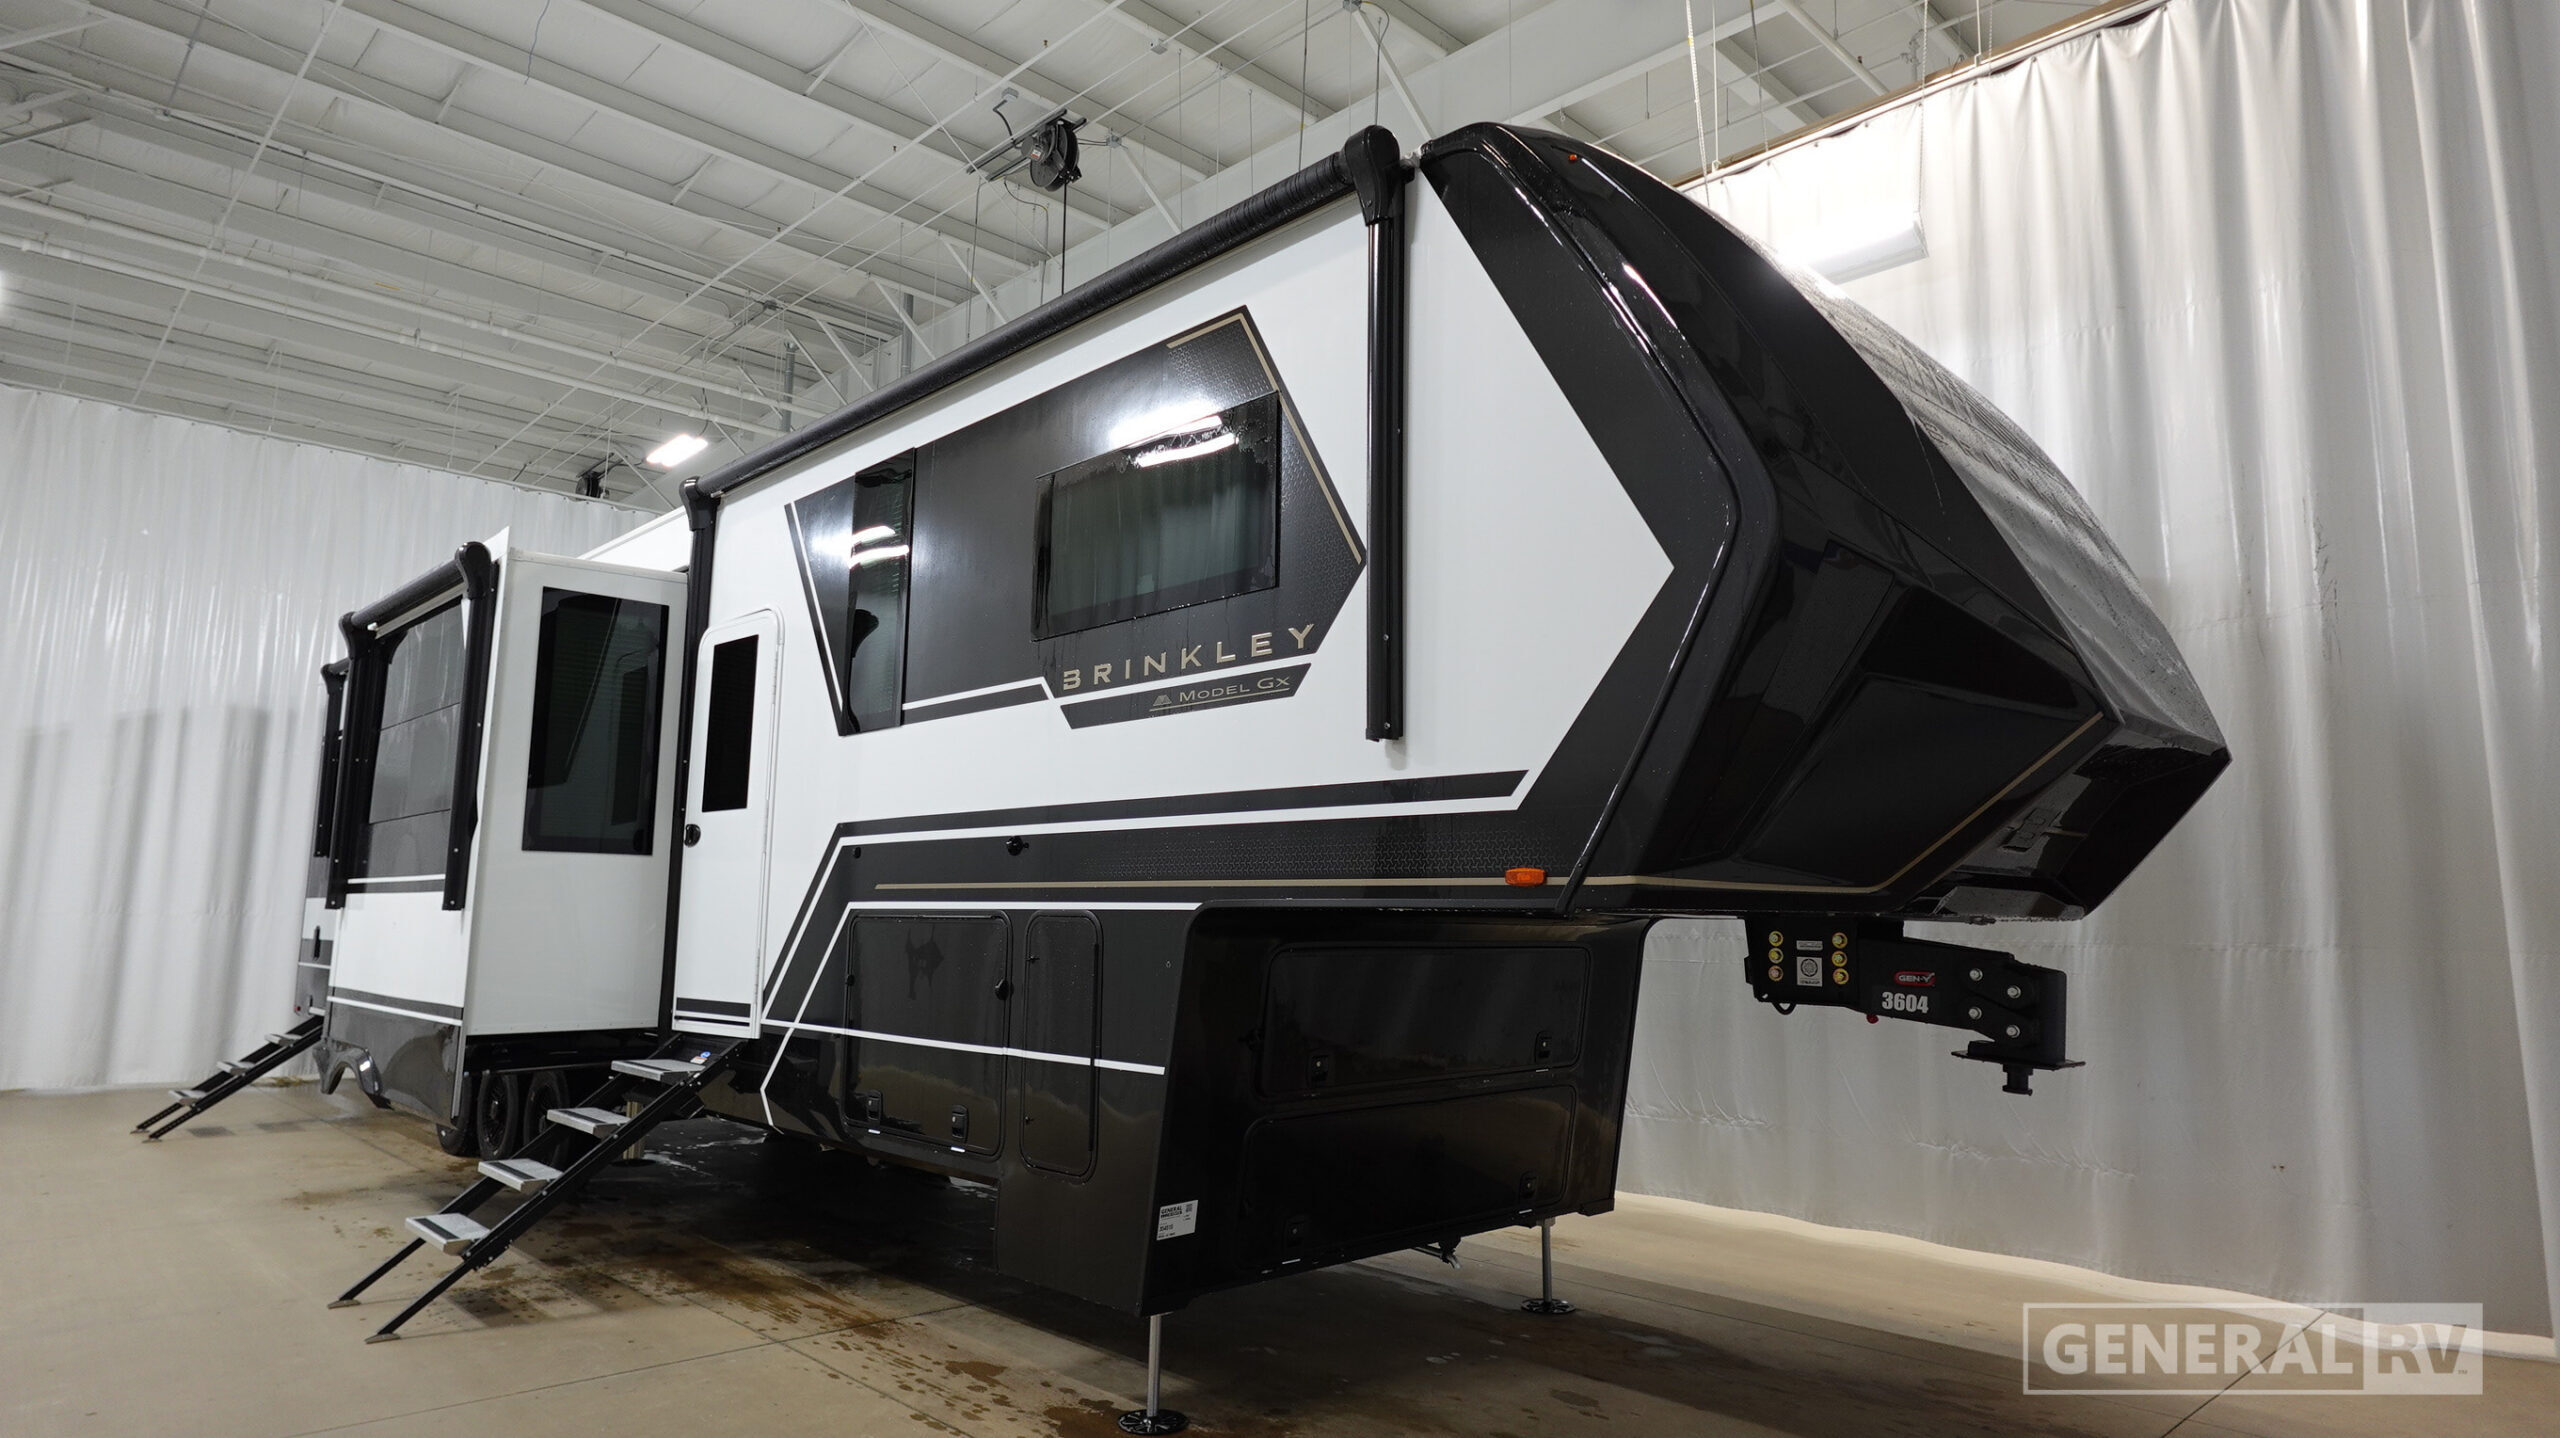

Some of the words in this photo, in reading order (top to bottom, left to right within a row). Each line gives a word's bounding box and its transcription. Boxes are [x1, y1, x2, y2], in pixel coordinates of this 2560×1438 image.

[1063, 623, 1314, 691] BRINKLEY
[1898, 972, 1935, 982] GEN-Y
[1881, 991, 1929, 1014] 3604
